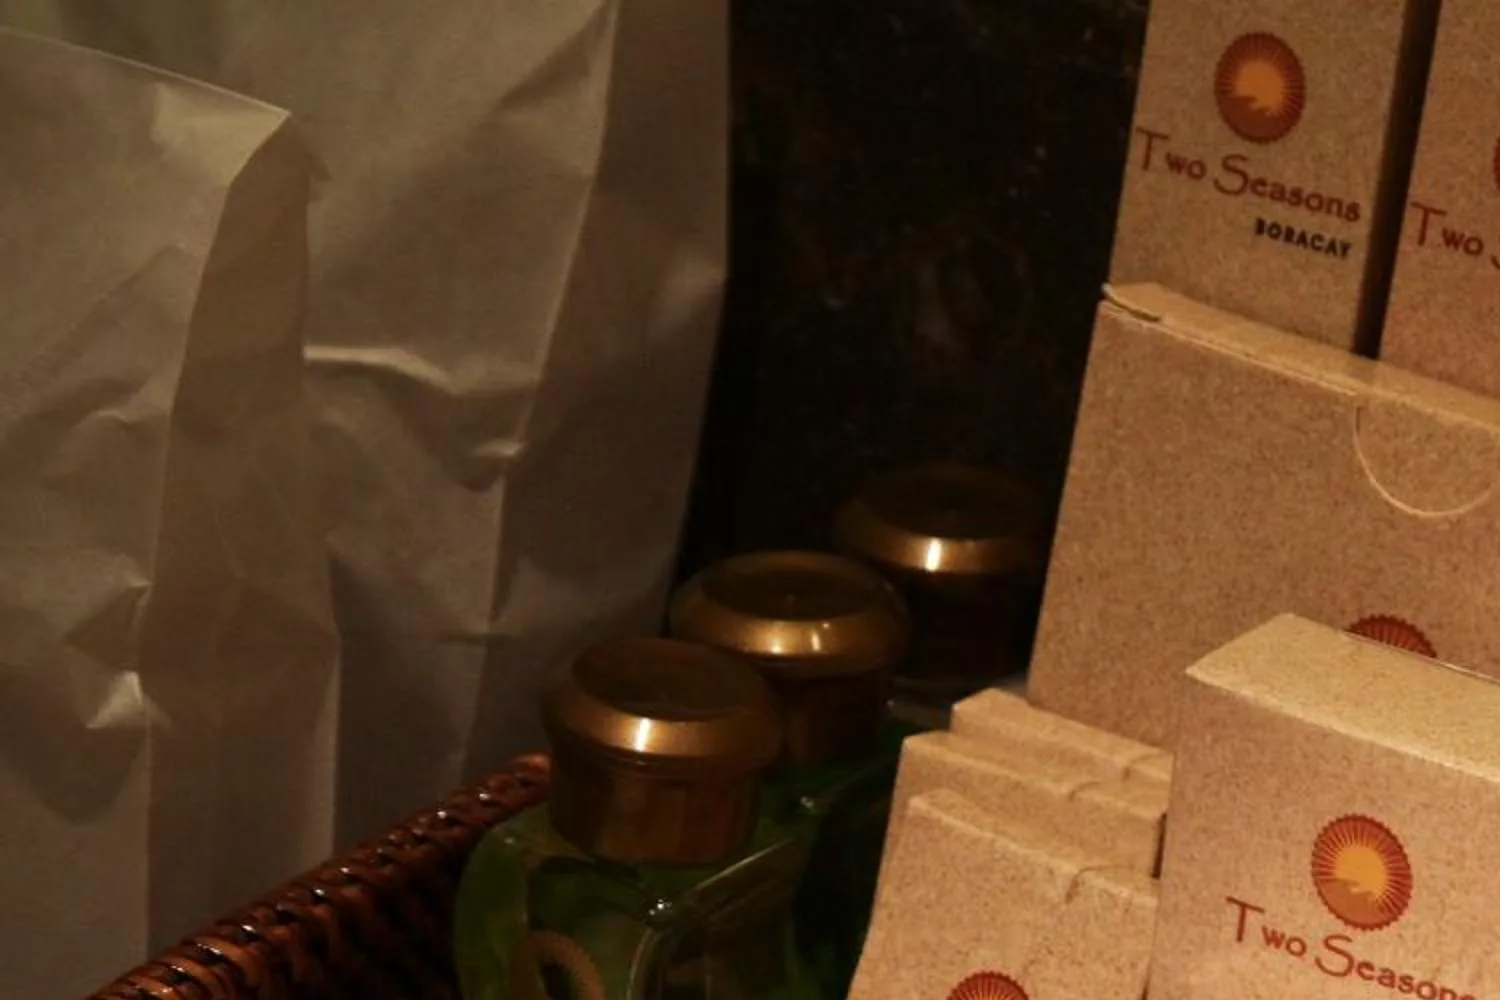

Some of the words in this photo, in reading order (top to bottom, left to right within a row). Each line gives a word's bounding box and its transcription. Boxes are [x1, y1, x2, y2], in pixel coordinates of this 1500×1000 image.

[1135, 127, 1207, 180] Two
[1214, 154, 1360, 222] Seasons
[1255, 217, 1352, 261] BORACAY
[1411, 201, 1484, 256] Two
[1226, 896, 1307, 957] Two
